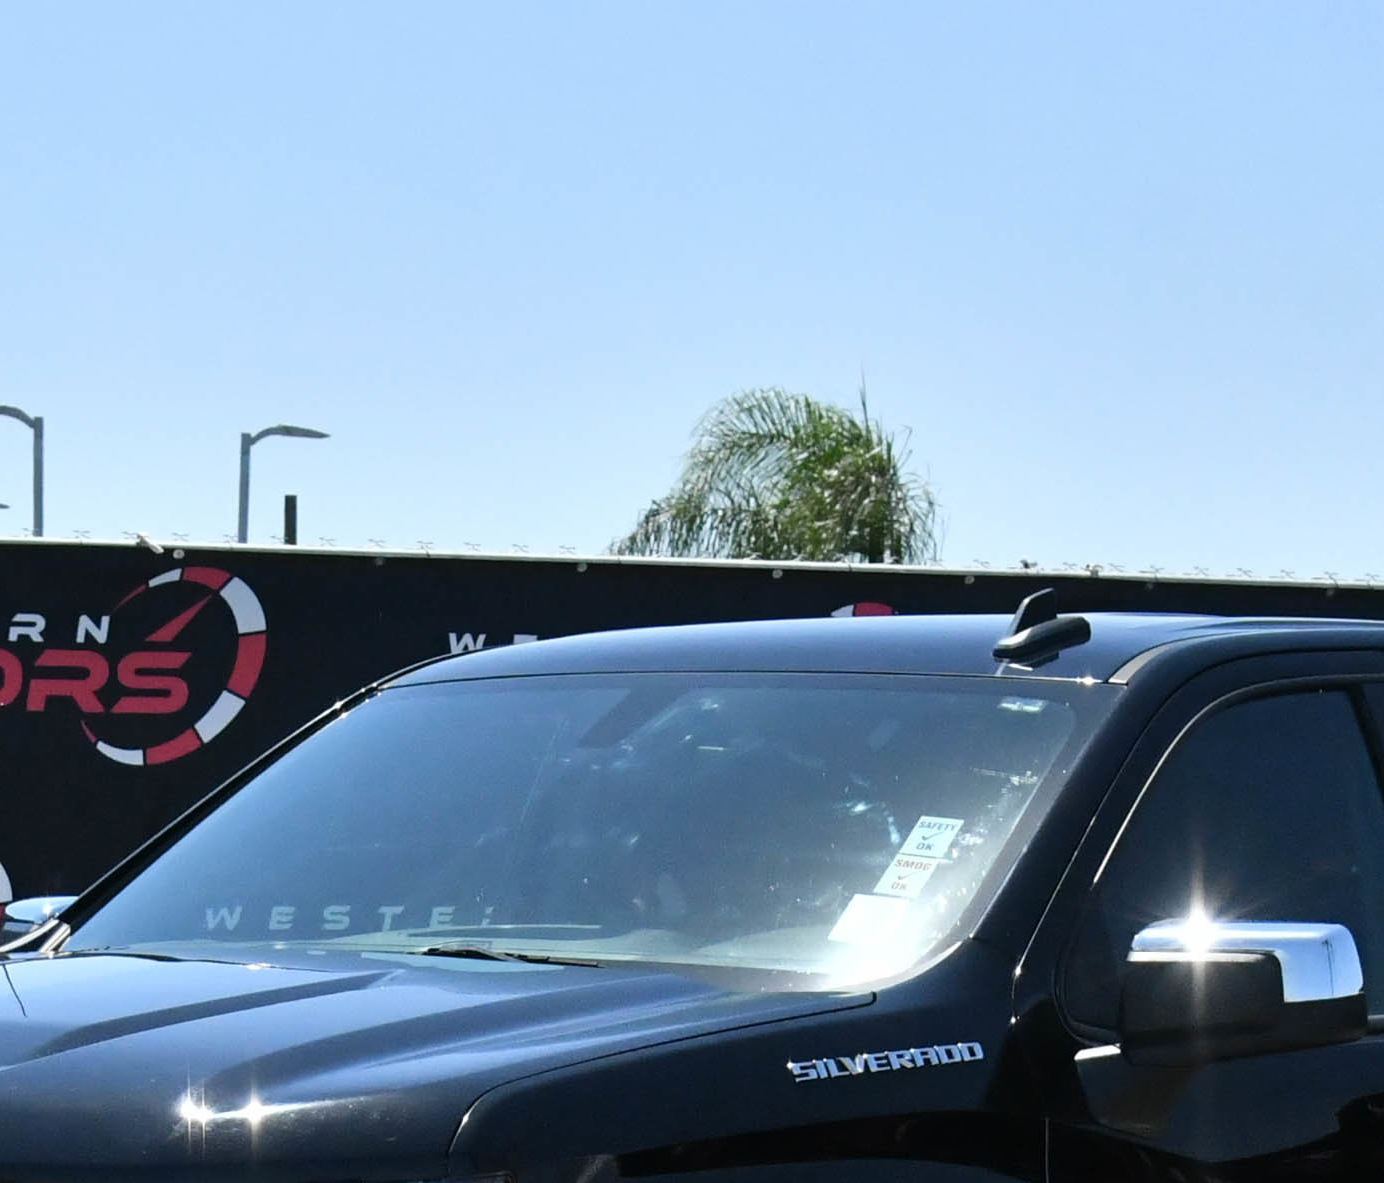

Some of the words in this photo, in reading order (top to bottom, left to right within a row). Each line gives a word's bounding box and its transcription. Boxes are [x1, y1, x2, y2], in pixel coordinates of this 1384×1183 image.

[918, 821, 958, 831] SAFETY
[916, 842, 934, 851] OK
[895, 859, 932, 871] SMOG
[787, 1042, 985, 1083] SILVERADO
